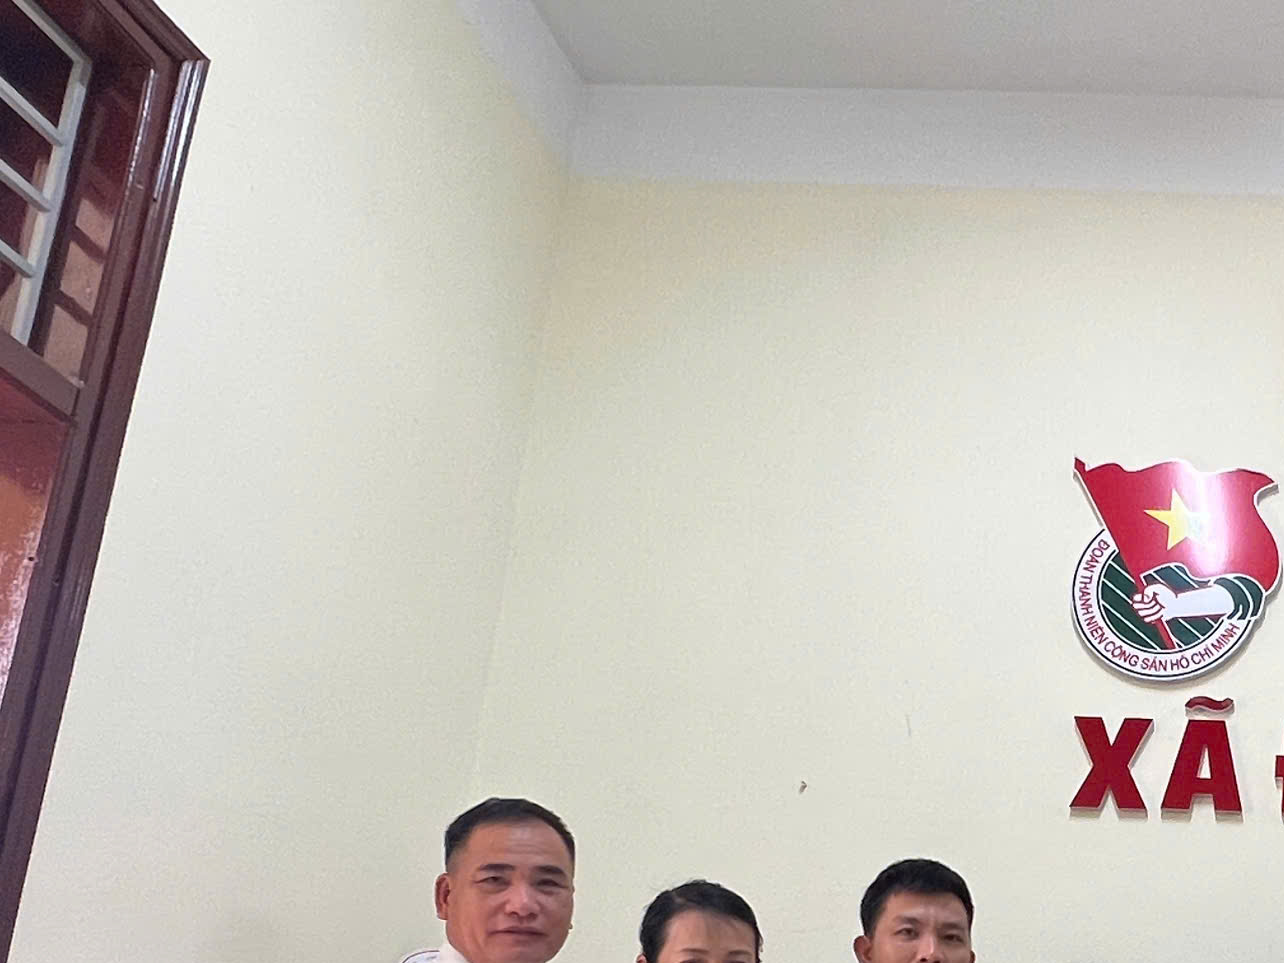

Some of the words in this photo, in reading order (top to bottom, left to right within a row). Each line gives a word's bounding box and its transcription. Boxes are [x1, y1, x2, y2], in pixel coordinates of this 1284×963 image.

[1079, 575, 1093, 616] THANH
[1191, 644, 1214, 664] CHÍ
[1211, 622, 1240, 652] MINH
[1069, 696, 1242, 812] XÃ
